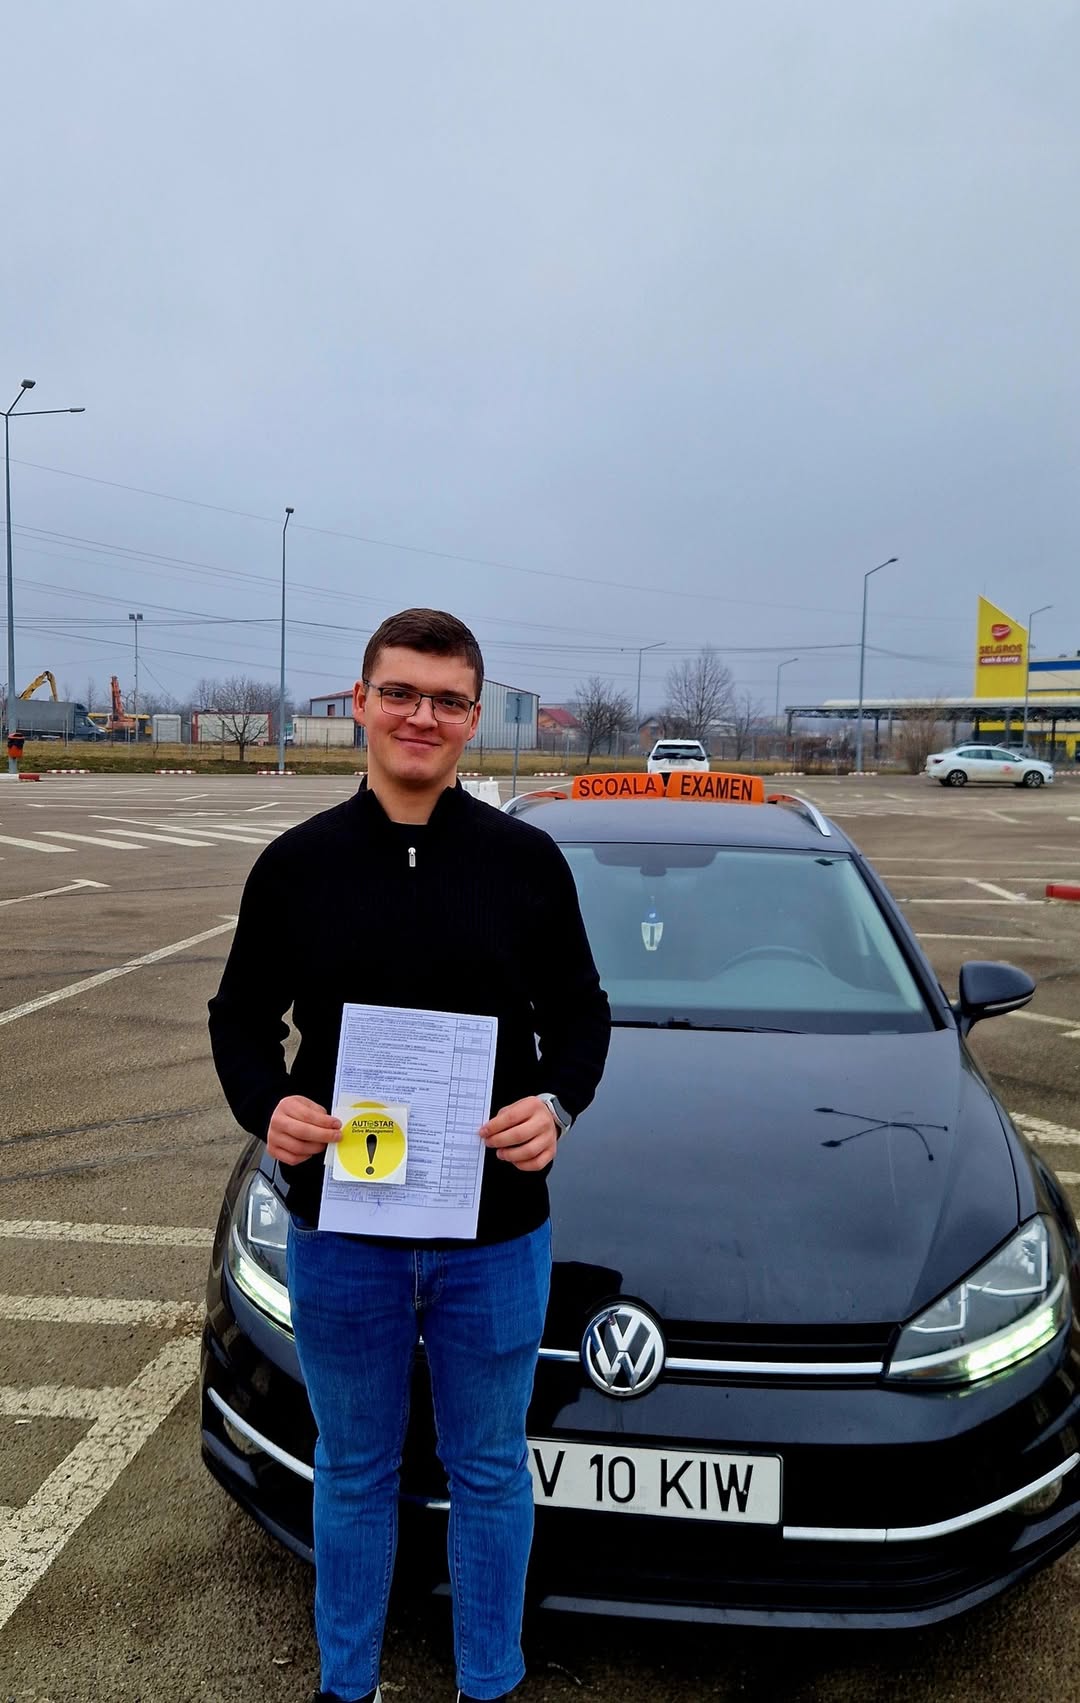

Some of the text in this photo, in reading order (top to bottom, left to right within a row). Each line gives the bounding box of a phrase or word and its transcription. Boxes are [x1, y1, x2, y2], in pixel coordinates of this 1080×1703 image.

[979, 644, 1022, 654] SELGROS
[981, 656, 996, 664] cash
[1002, 655, 1019, 664] carry
[578, 774, 753, 801] SCOALA EXAMEN
[583, 1304, 664, 1395] VW
[589, 1453, 636, 1504] 10
[660, 1458, 754, 1513] KIW
